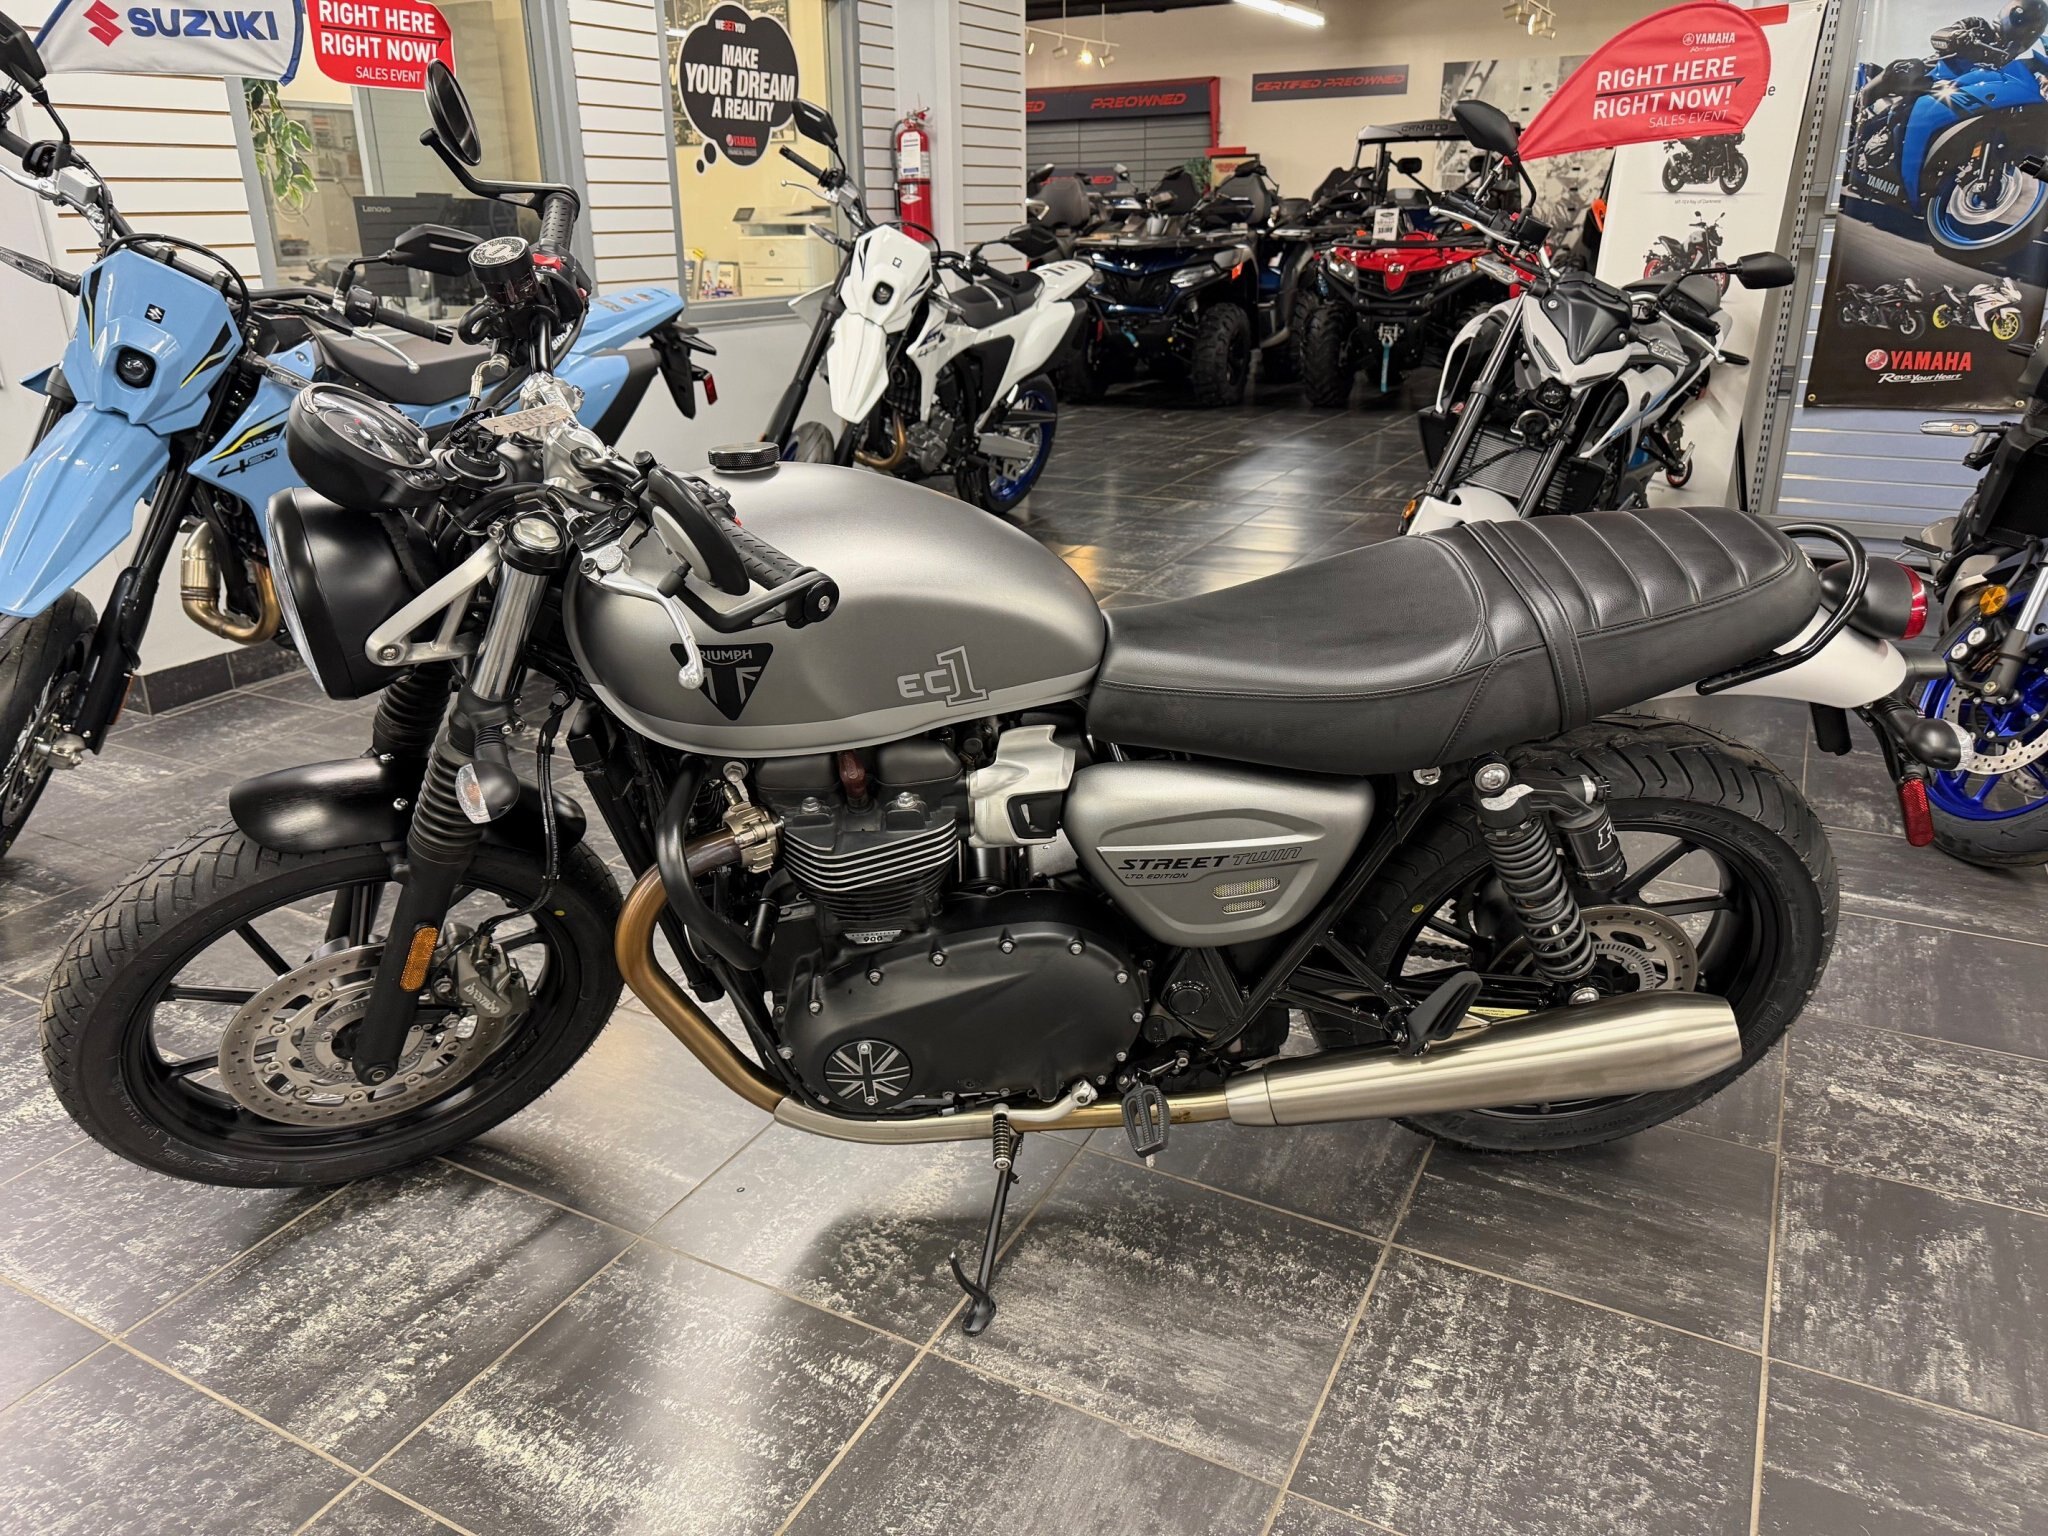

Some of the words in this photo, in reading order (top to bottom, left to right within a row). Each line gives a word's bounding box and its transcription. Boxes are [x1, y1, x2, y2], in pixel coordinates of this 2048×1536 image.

[127, 7, 280, 41] SUZUKI
[319, 0, 381, 31] RIGHT
[385, 7, 436, 35] HERE
[321, 32, 382, 60] RIGHT
[386, 36, 437, 64] NOW!
[1695, 32, 1736, 44] YAMAHA
[722, 44, 759, 70] MAKE
[355, 65, 389, 81] SALES
[390, 68, 422, 84] EVENT
[685, 62, 733, 96] YOUR
[736, 69, 796, 102] DREAM
[1255, 78, 1322, 92] CERTIFIED
[1322, 74, 1406, 90] PREOWNED
[1596, 63, 1668, 92] RIGHT
[1673, 56, 1737, 83] HERE
[712, 96, 722, 118] A
[724, 98, 775, 122] REALITY
[1090, 92, 1187, 110] PREOWNED
[1593, 93, 1664, 120] RIGHT
[1668, 85, 1733, 111] NOW!
[1648, 113, 1686, 128] SALES
[1688, 109, 1728, 124] EVENT
[1866, 174, 1900, 197] YAMAHA
[362, 205, 392, 213] Lenovo
[1890, 351, 1972, 372] YAMAHA
[699, 649, 753, 663] RIUMPH
[896, 645, 990, 707] EC1
[1118, 854, 1231, 870] STREET
[1232, 846, 1303, 866] TWIN
[463, 982, 501, 1014] brembo
